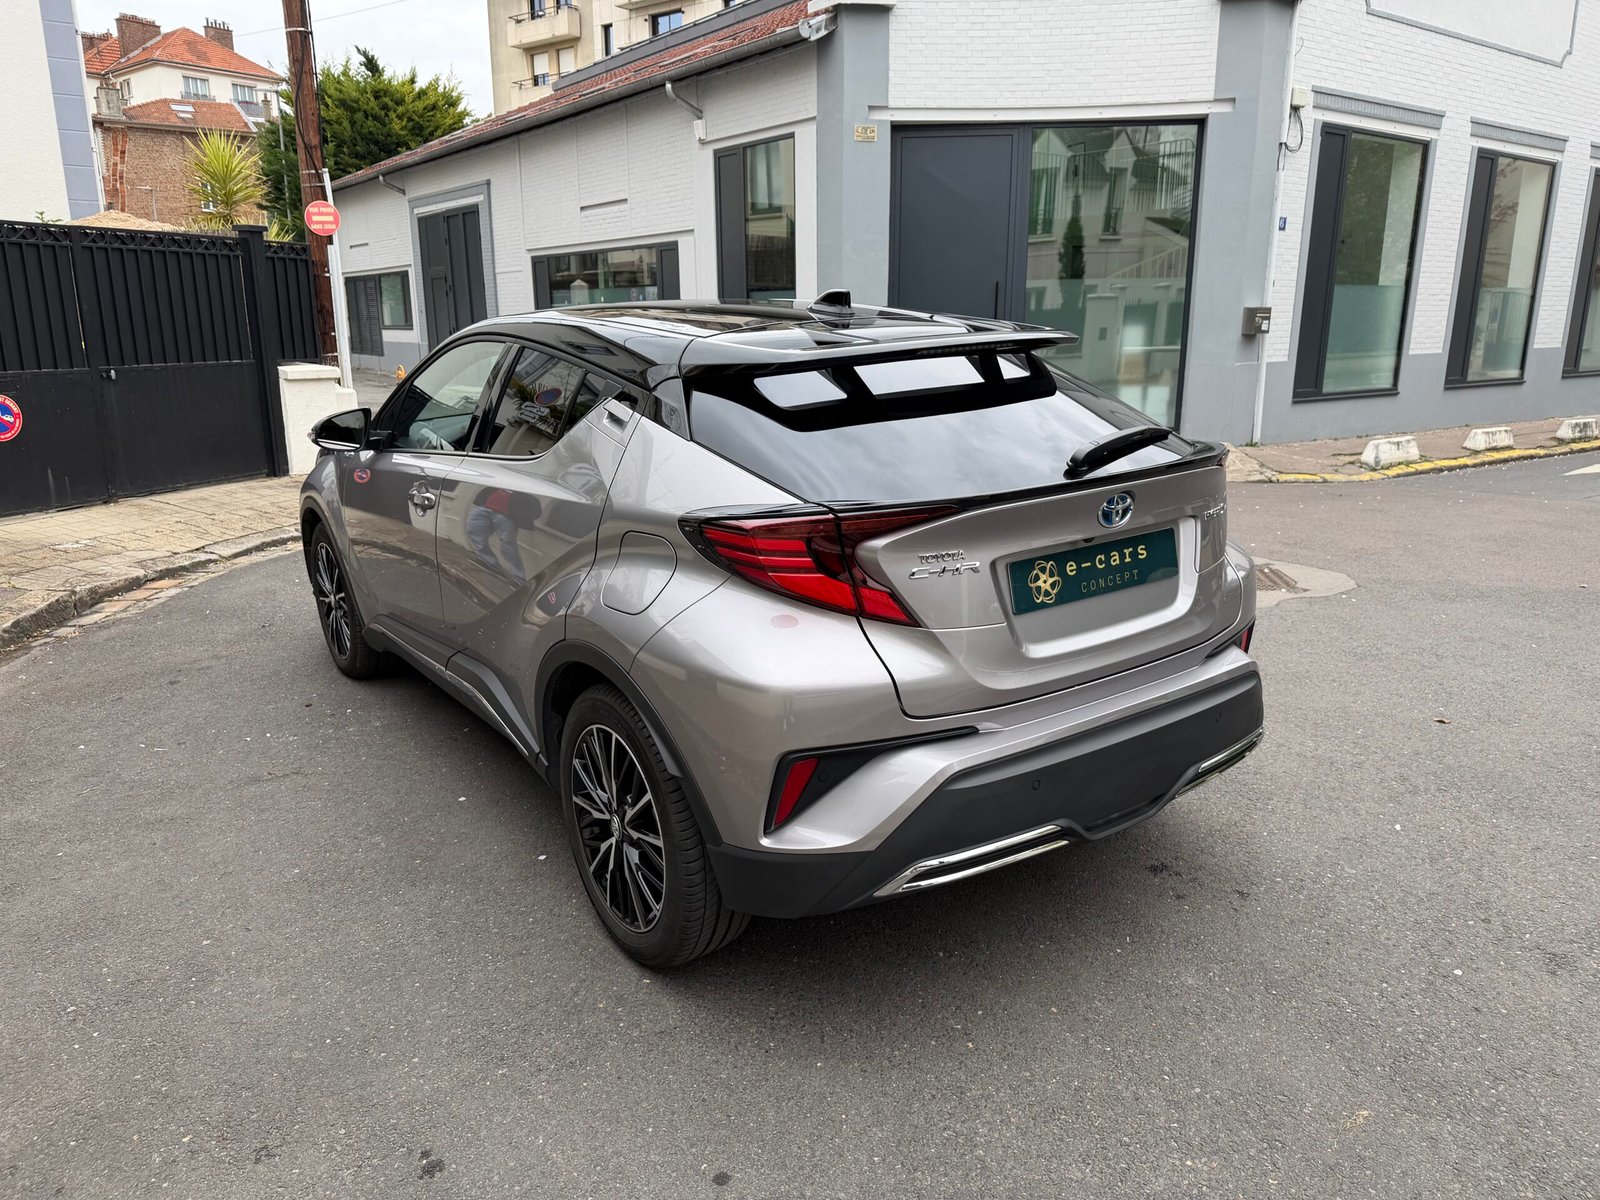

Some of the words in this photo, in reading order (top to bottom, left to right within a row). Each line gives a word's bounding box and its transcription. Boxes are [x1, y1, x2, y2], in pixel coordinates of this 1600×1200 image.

[918, 549, 966, 564] TOYOTA
[1066, 544, 1147, 576] e-cars
[908, 561, 981, 580] C-HR
[1081, 569, 1139, 593] CONCEPT
